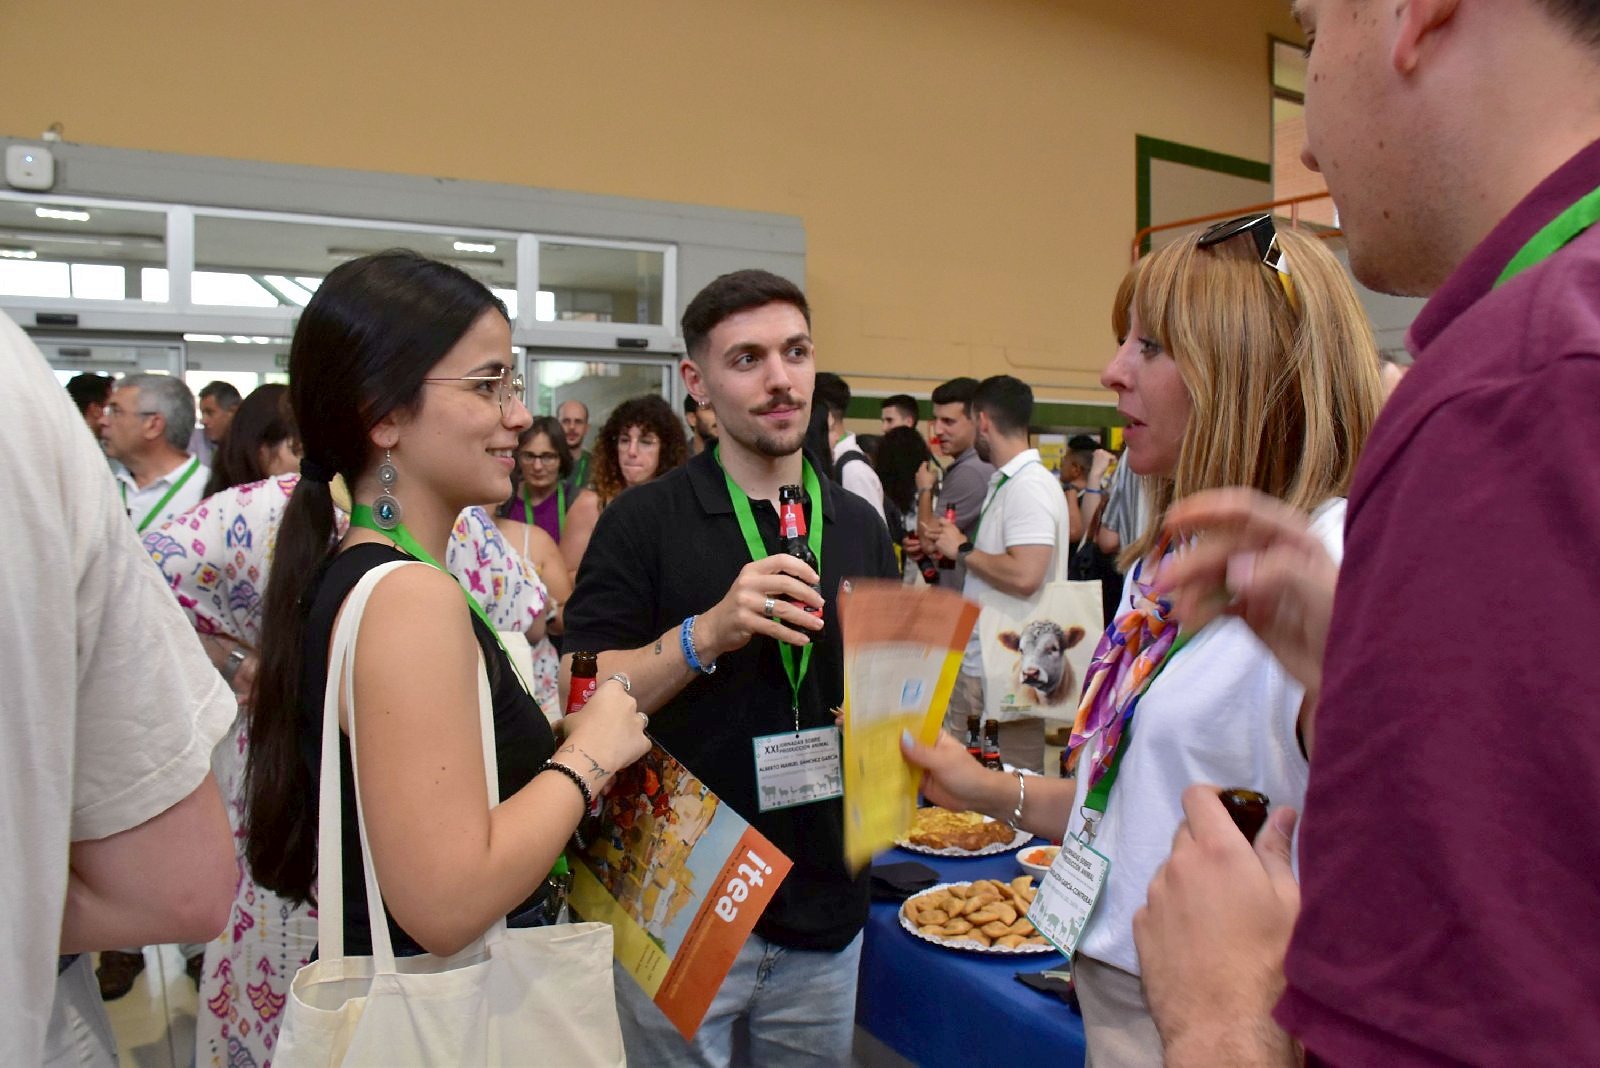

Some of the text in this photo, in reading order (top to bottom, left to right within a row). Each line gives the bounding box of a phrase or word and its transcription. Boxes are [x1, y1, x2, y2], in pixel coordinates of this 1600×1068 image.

[779, 736, 821, 748] JORNADAS SOBRE
[764, 744, 779, 754] XXI
[759, 764, 780, 772] ALBERTO
[780, 761, 799, 769] MANUEL
[714, 849, 773, 923] itea
